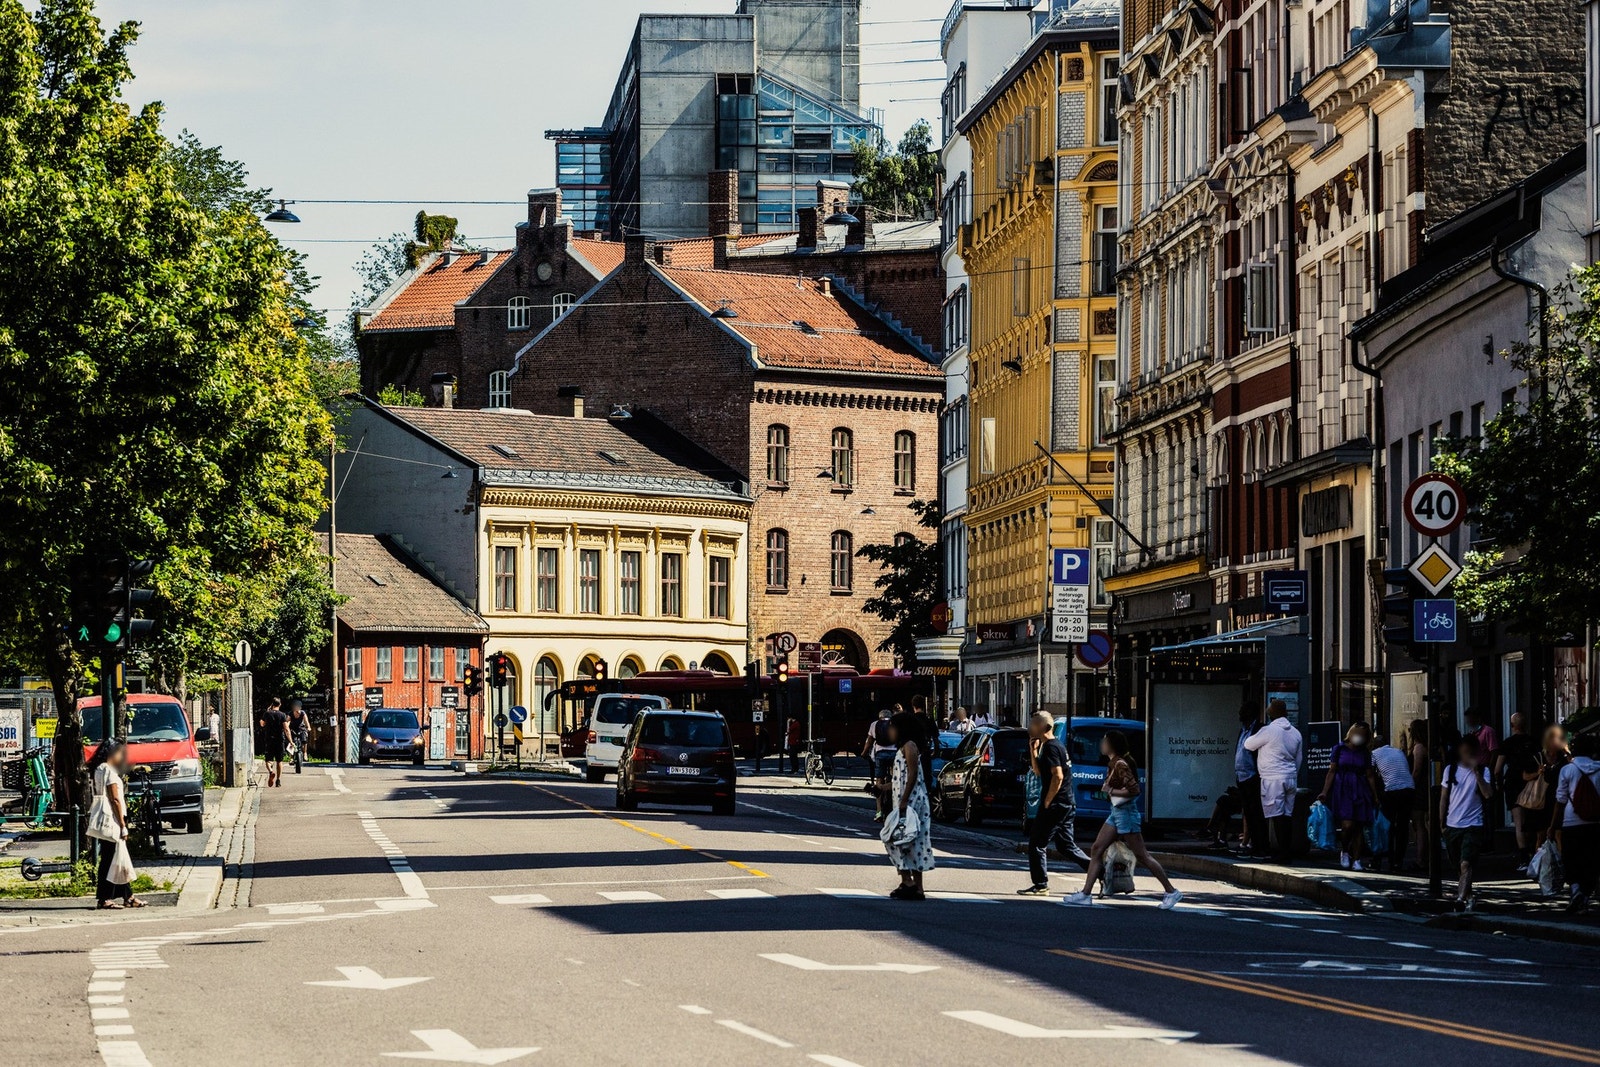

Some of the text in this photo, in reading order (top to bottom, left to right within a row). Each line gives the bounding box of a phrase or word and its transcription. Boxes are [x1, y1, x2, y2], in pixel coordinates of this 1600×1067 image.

[1415, 489, 1457, 520] 40
[1062, 553, 1081, 580] P
[914, 666, 956, 676] SUBWAY
[1168, 737, 1229, 747] Ride your bike like
[1176, 747, 1196, 757] might
[1196, 749, 1207, 757] get
[1071, 771, 1104, 780] ostnord
